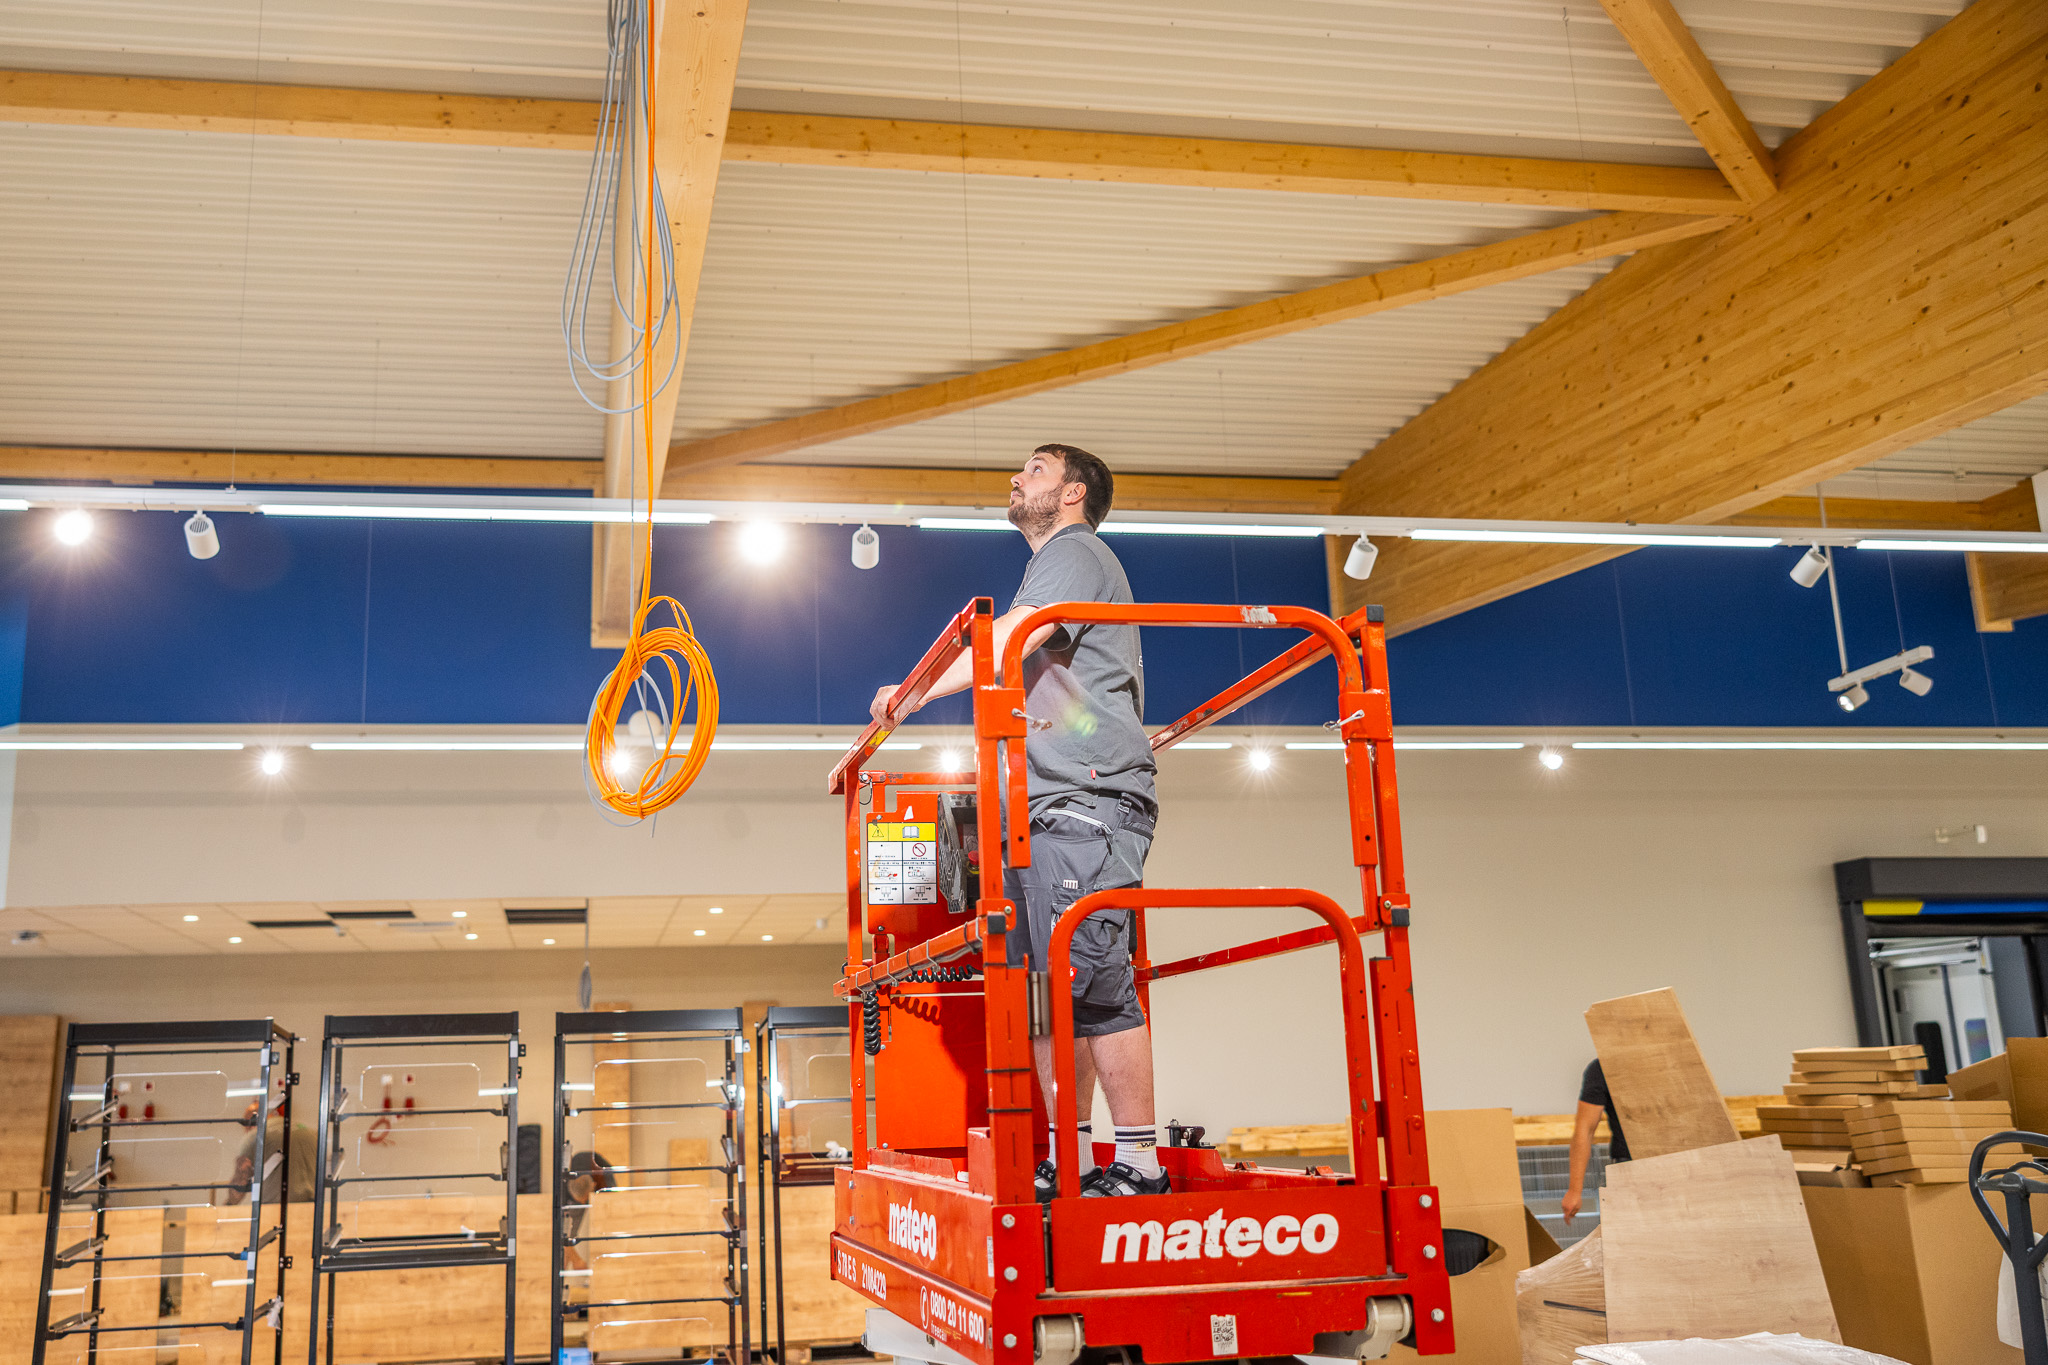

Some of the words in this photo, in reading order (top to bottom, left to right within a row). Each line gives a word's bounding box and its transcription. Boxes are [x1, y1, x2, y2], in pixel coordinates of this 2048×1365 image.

[888, 1197, 937, 1261] mateco
[1101, 1208, 1339, 1264] mateco
[930, 1290, 947, 1322] 0800
[947, 1299, 957, 1328] 20
[957, 1305, 967, 1335] 11
[968, 1310, 984, 1344] 600
